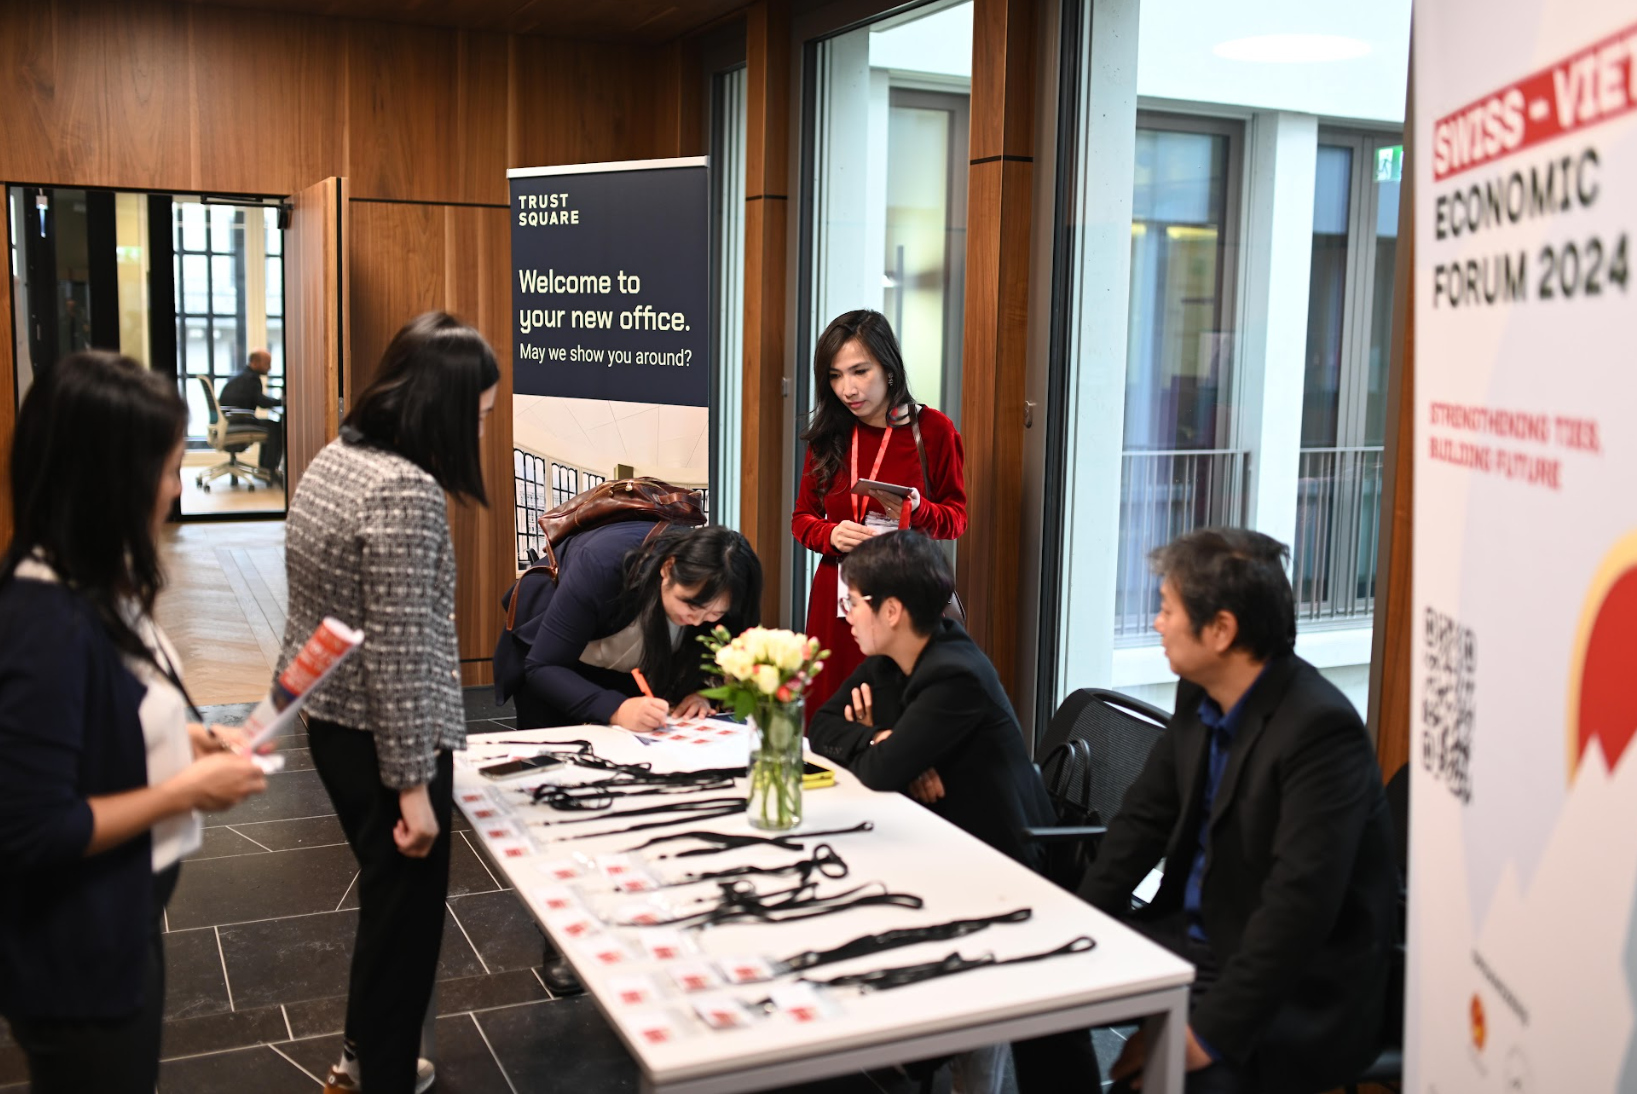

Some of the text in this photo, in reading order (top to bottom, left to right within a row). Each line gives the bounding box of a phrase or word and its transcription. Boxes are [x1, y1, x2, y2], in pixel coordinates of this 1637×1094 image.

[1435, 88, 1525, 176] SWISS
[518, 193, 569, 210] TRUST
[1435, 146, 1601, 241] ECONOMIC
[518, 210, 580, 227] SQUARE
[518, 268, 641, 294] Welcome to
[1434, 232, 1630, 309] FORUM 2024
[519, 304, 691, 334] your new office.
[519, 342, 693, 367] May we show you around?
